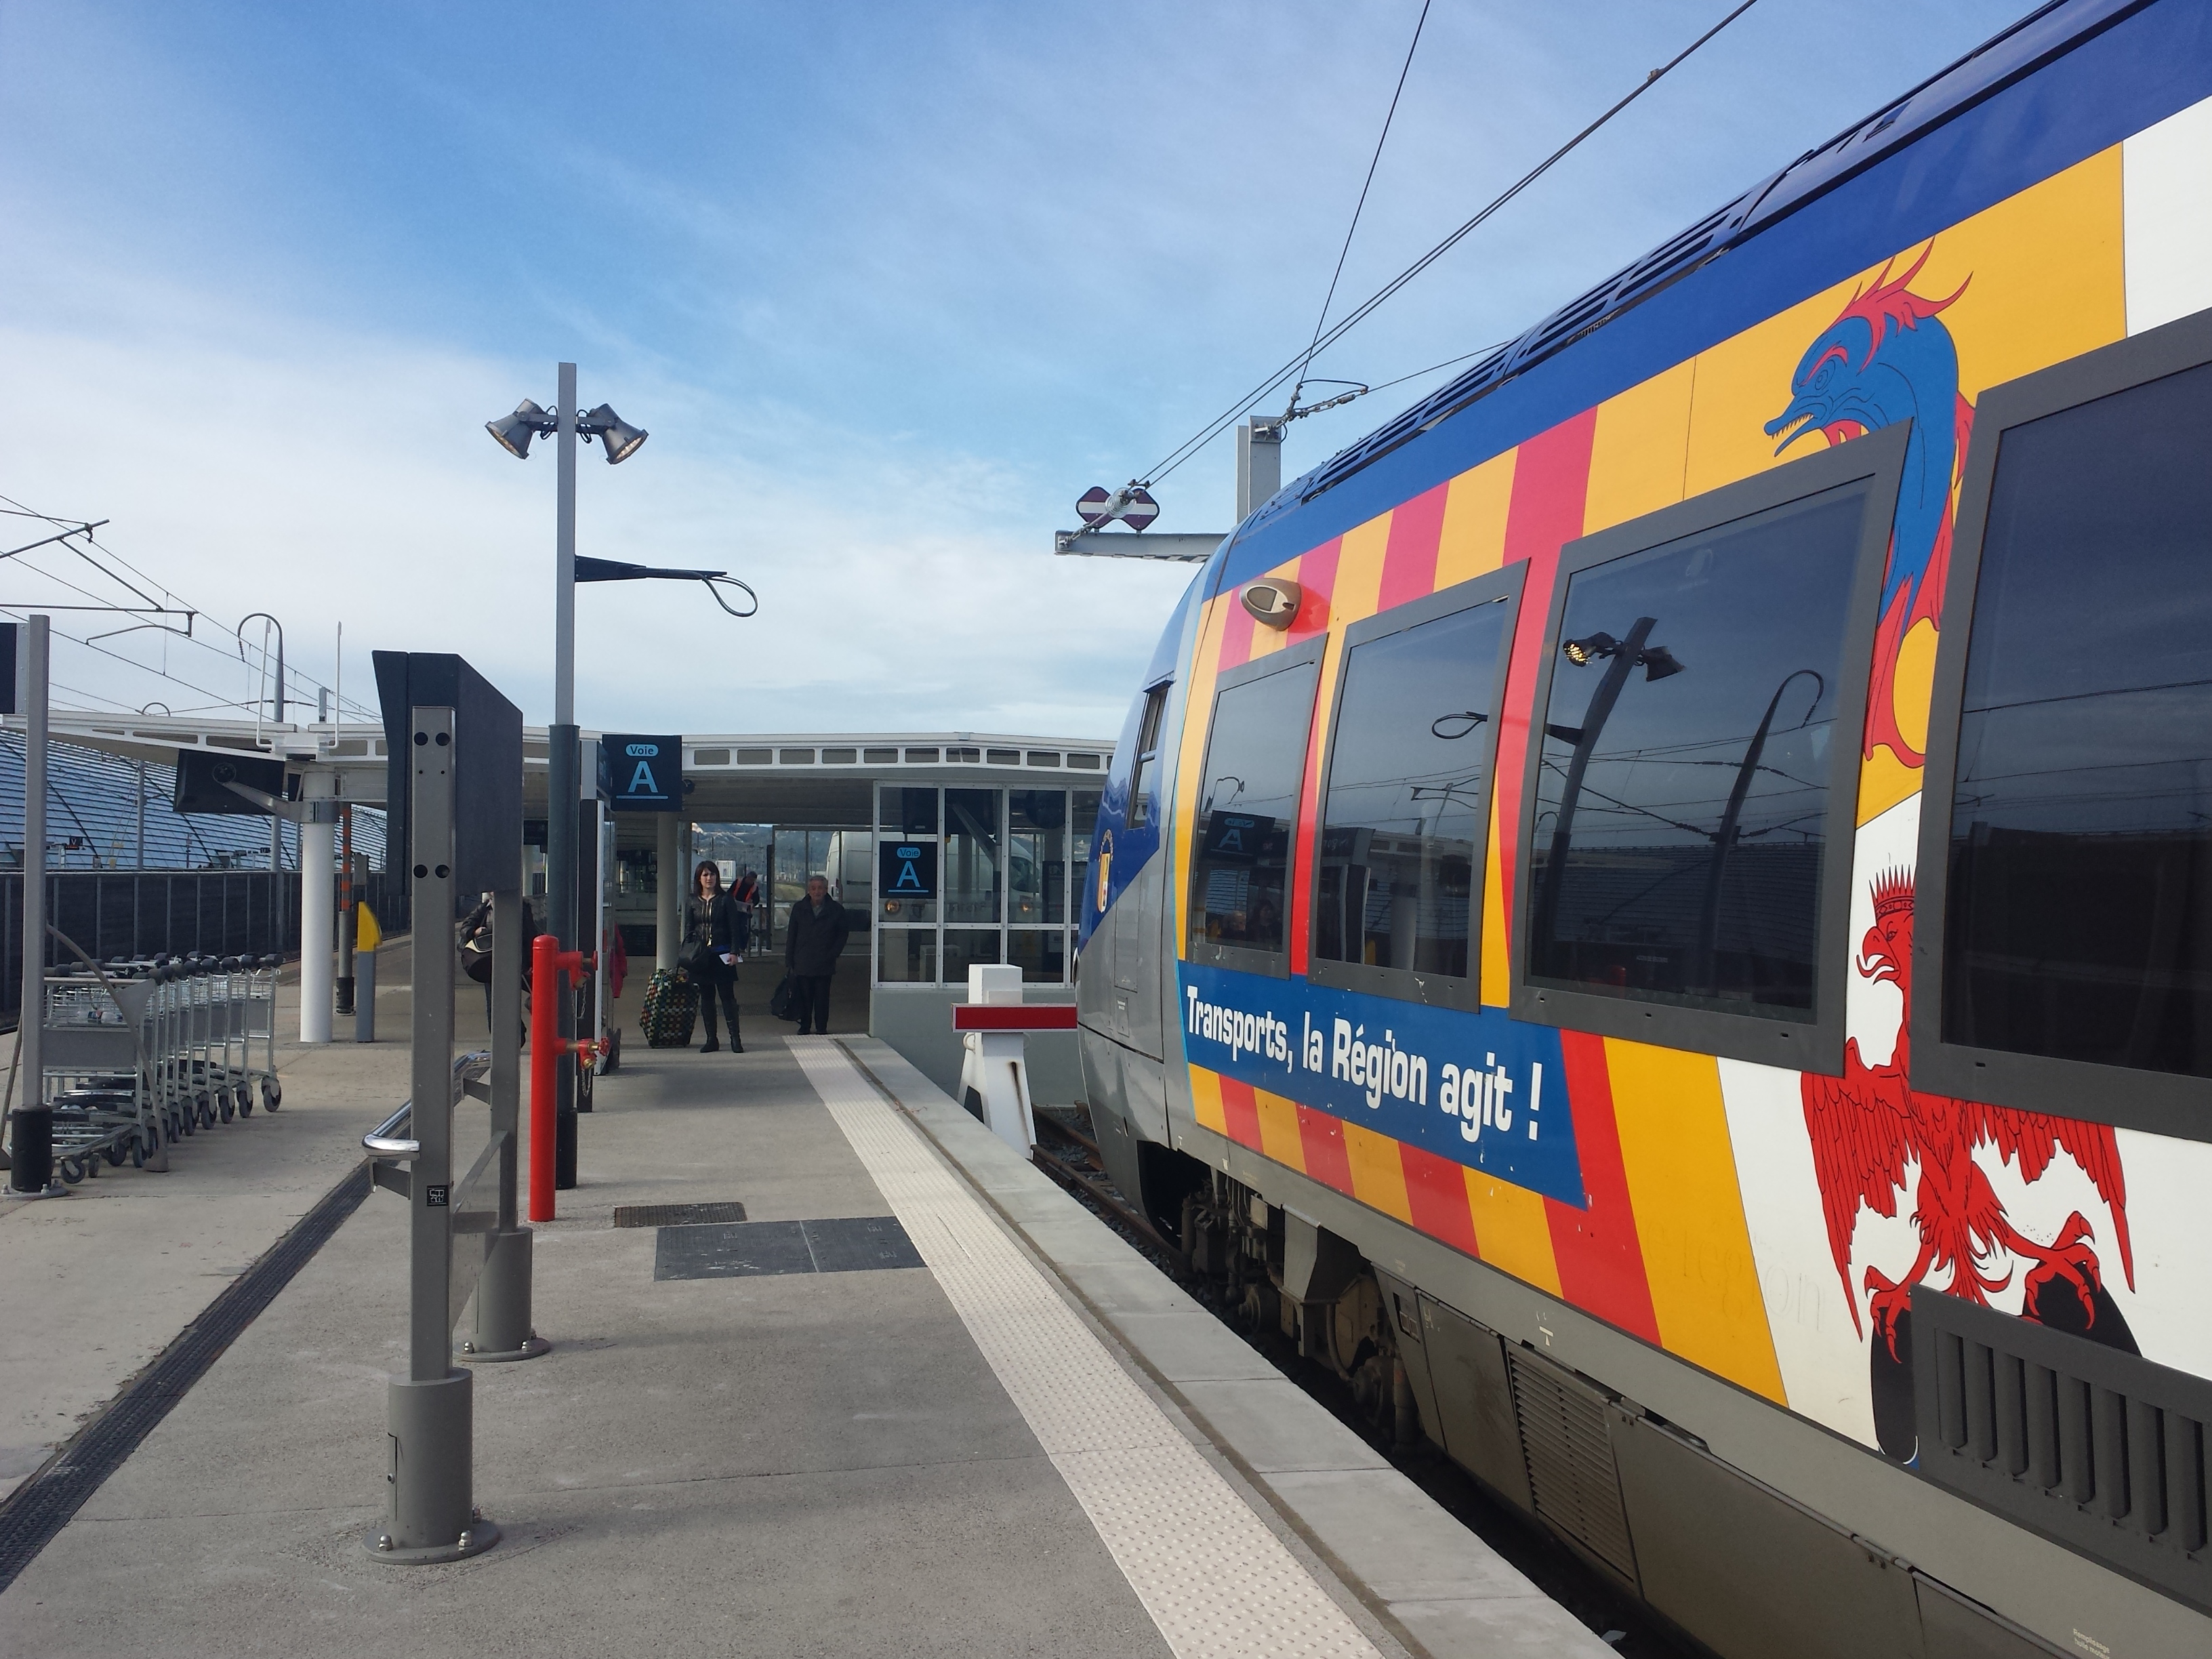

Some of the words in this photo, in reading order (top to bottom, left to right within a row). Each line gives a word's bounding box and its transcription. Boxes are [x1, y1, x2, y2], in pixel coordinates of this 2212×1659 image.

[630, 745, 655, 755] Voie
[628, 760, 659, 793] A
[899, 848, 920, 857] Voie
[897, 861, 921, 887] A
[1187, 985, 1293, 1073] Transports,
[1303, 1011, 1324, 1073] la
[1332, 1018, 1427, 1109] Région
[1440, 1052, 1513, 1143] agit
[1528, 1062, 1542, 1141] !
